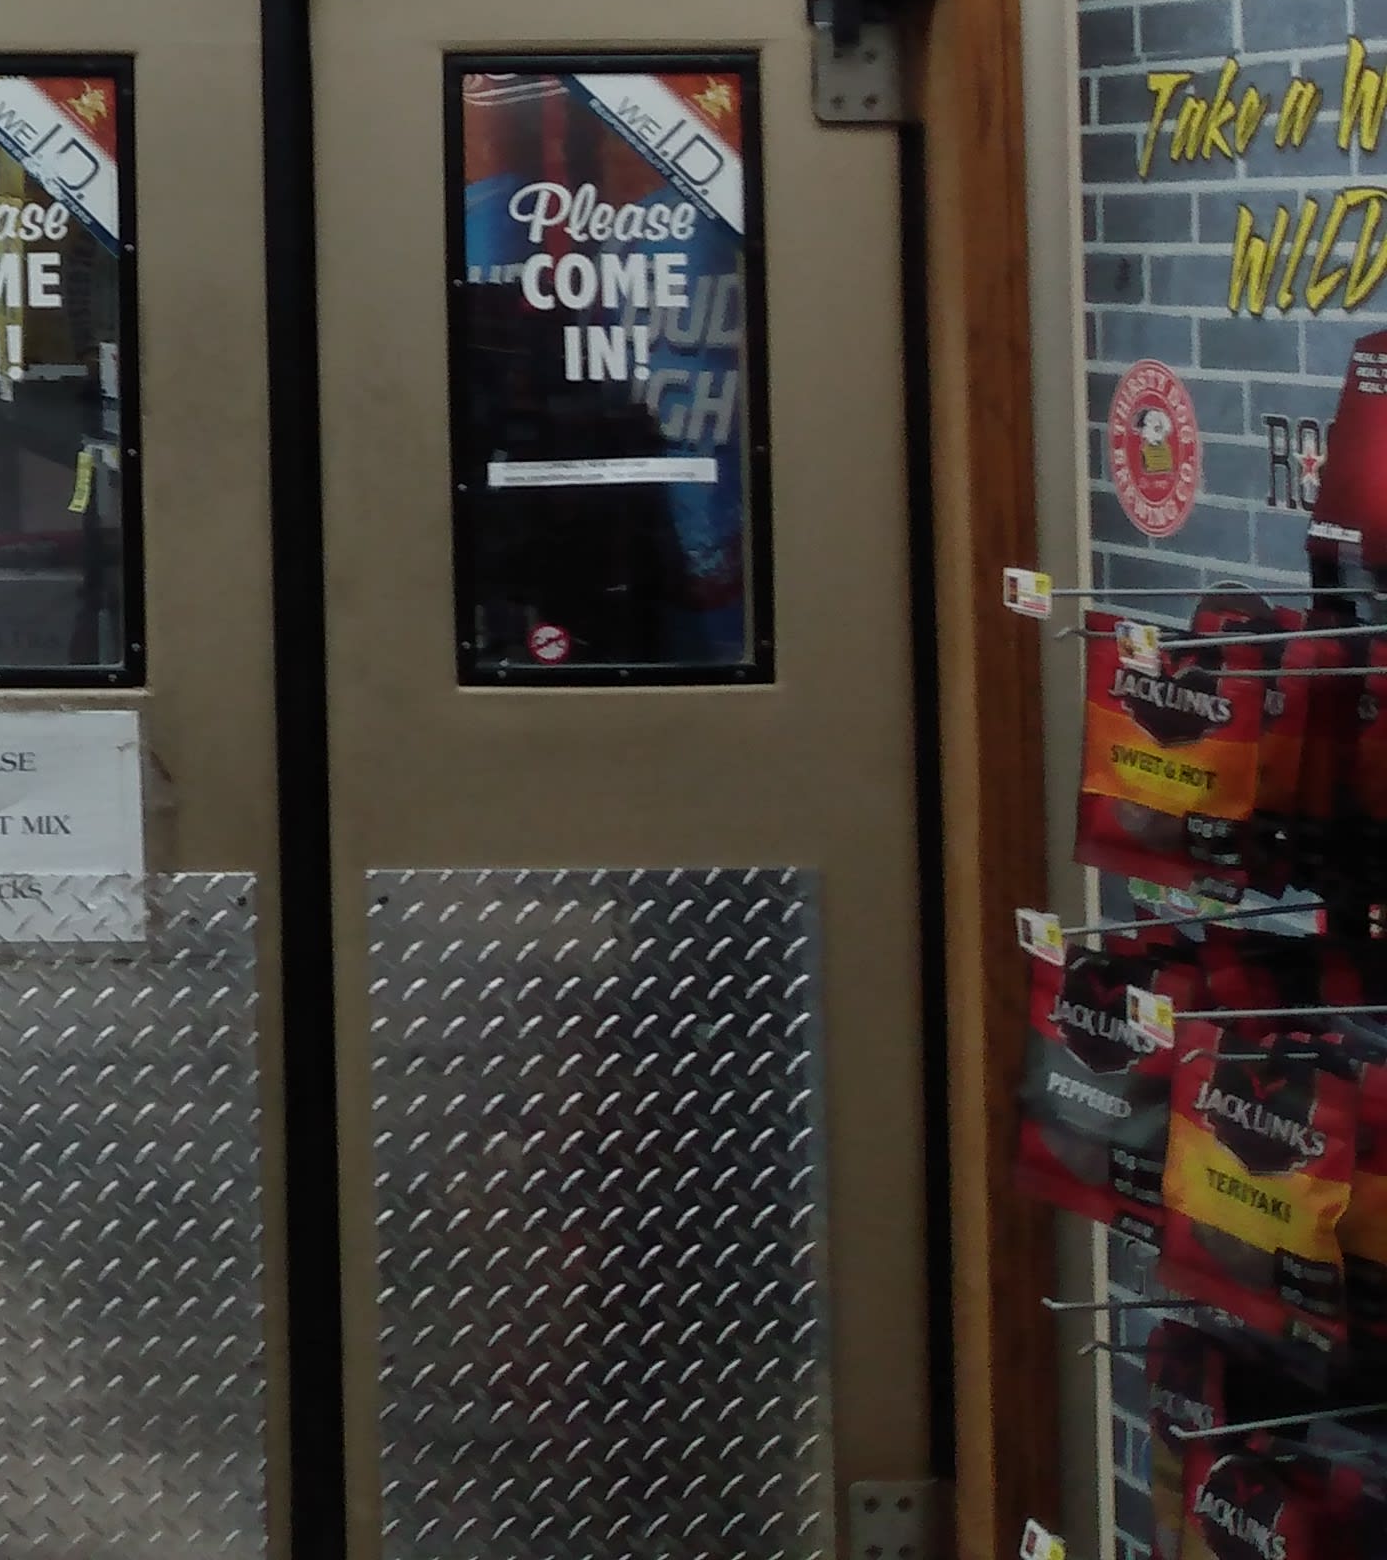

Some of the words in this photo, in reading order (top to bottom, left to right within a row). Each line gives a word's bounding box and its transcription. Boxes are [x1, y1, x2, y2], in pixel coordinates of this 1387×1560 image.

[617, 96, 662, 141] WE
[655, 119, 723, 195] I.D.
[1136, 56, 1268, 181] Take
[1275, 76, 1322, 150] a
[508, 181, 699, 245] Please
[522, 253, 691, 310] COME
[562, 325, 651, 383] IN!
[1108, 667, 1166, 708] JACK
[1111, 744, 1163, 775] SWEET
[21, 815, 72, 835] MIX
[1193, 1081, 1251, 1130] JACK
[1206, 1167, 1292, 1224] TERIYAKI
